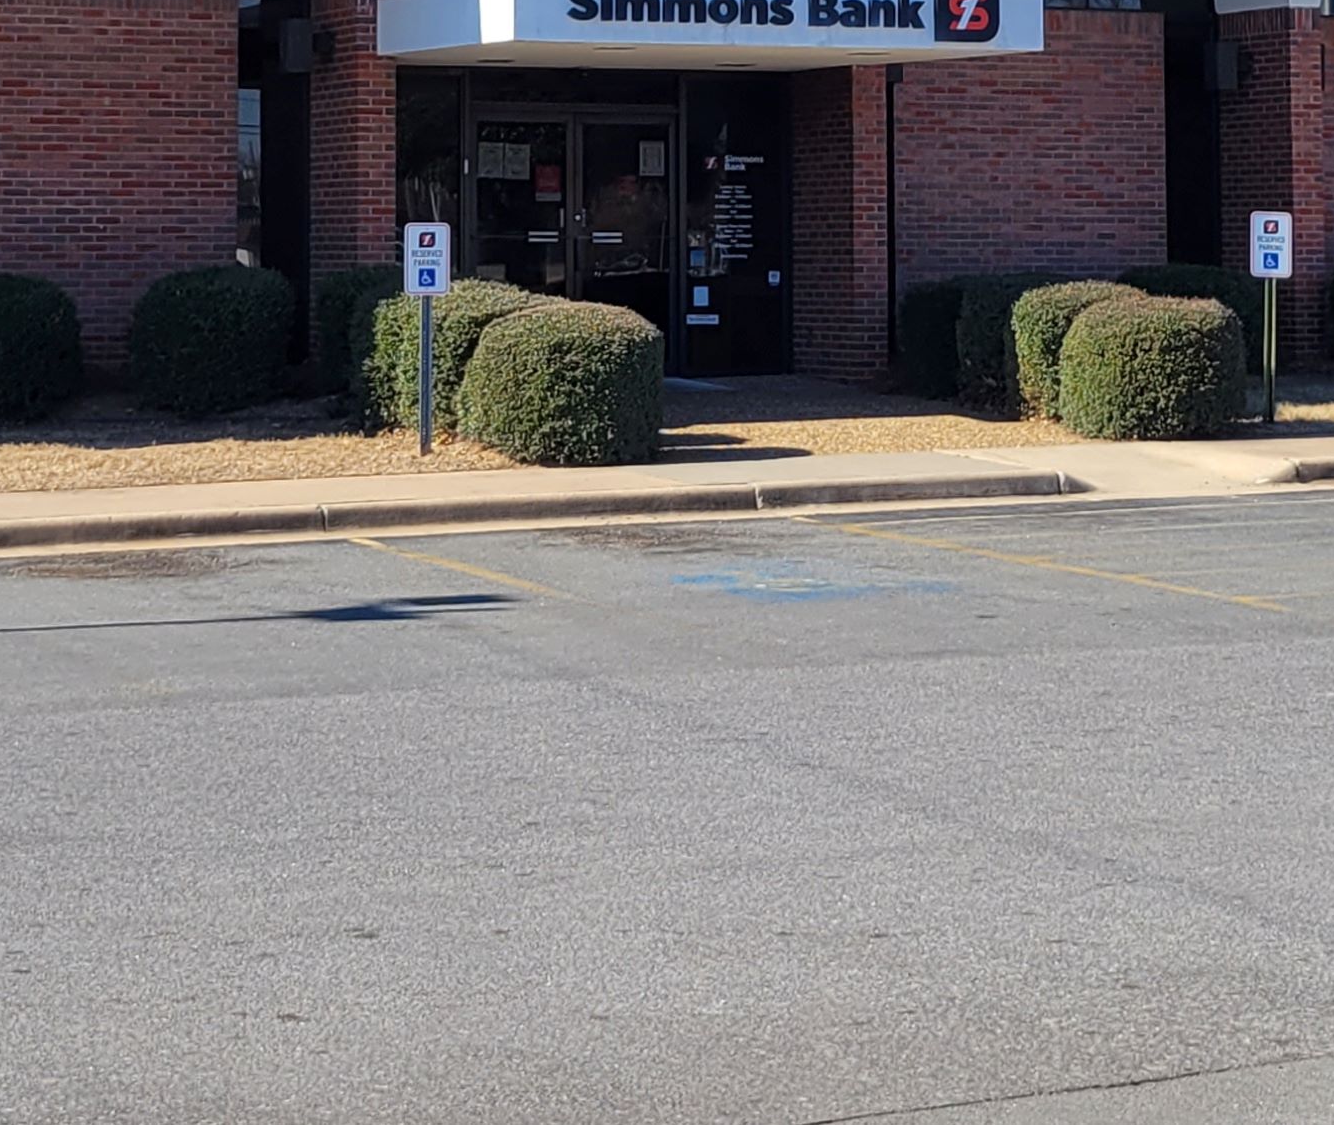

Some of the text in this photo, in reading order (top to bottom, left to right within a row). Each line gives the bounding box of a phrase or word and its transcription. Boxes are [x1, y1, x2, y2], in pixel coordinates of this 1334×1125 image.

[724, 154, 764, 163] Simmons
[724, 162, 746, 171] Bank
[411, 249, 443, 257] RESERVED
[413, 258, 441, 267] PARKING
